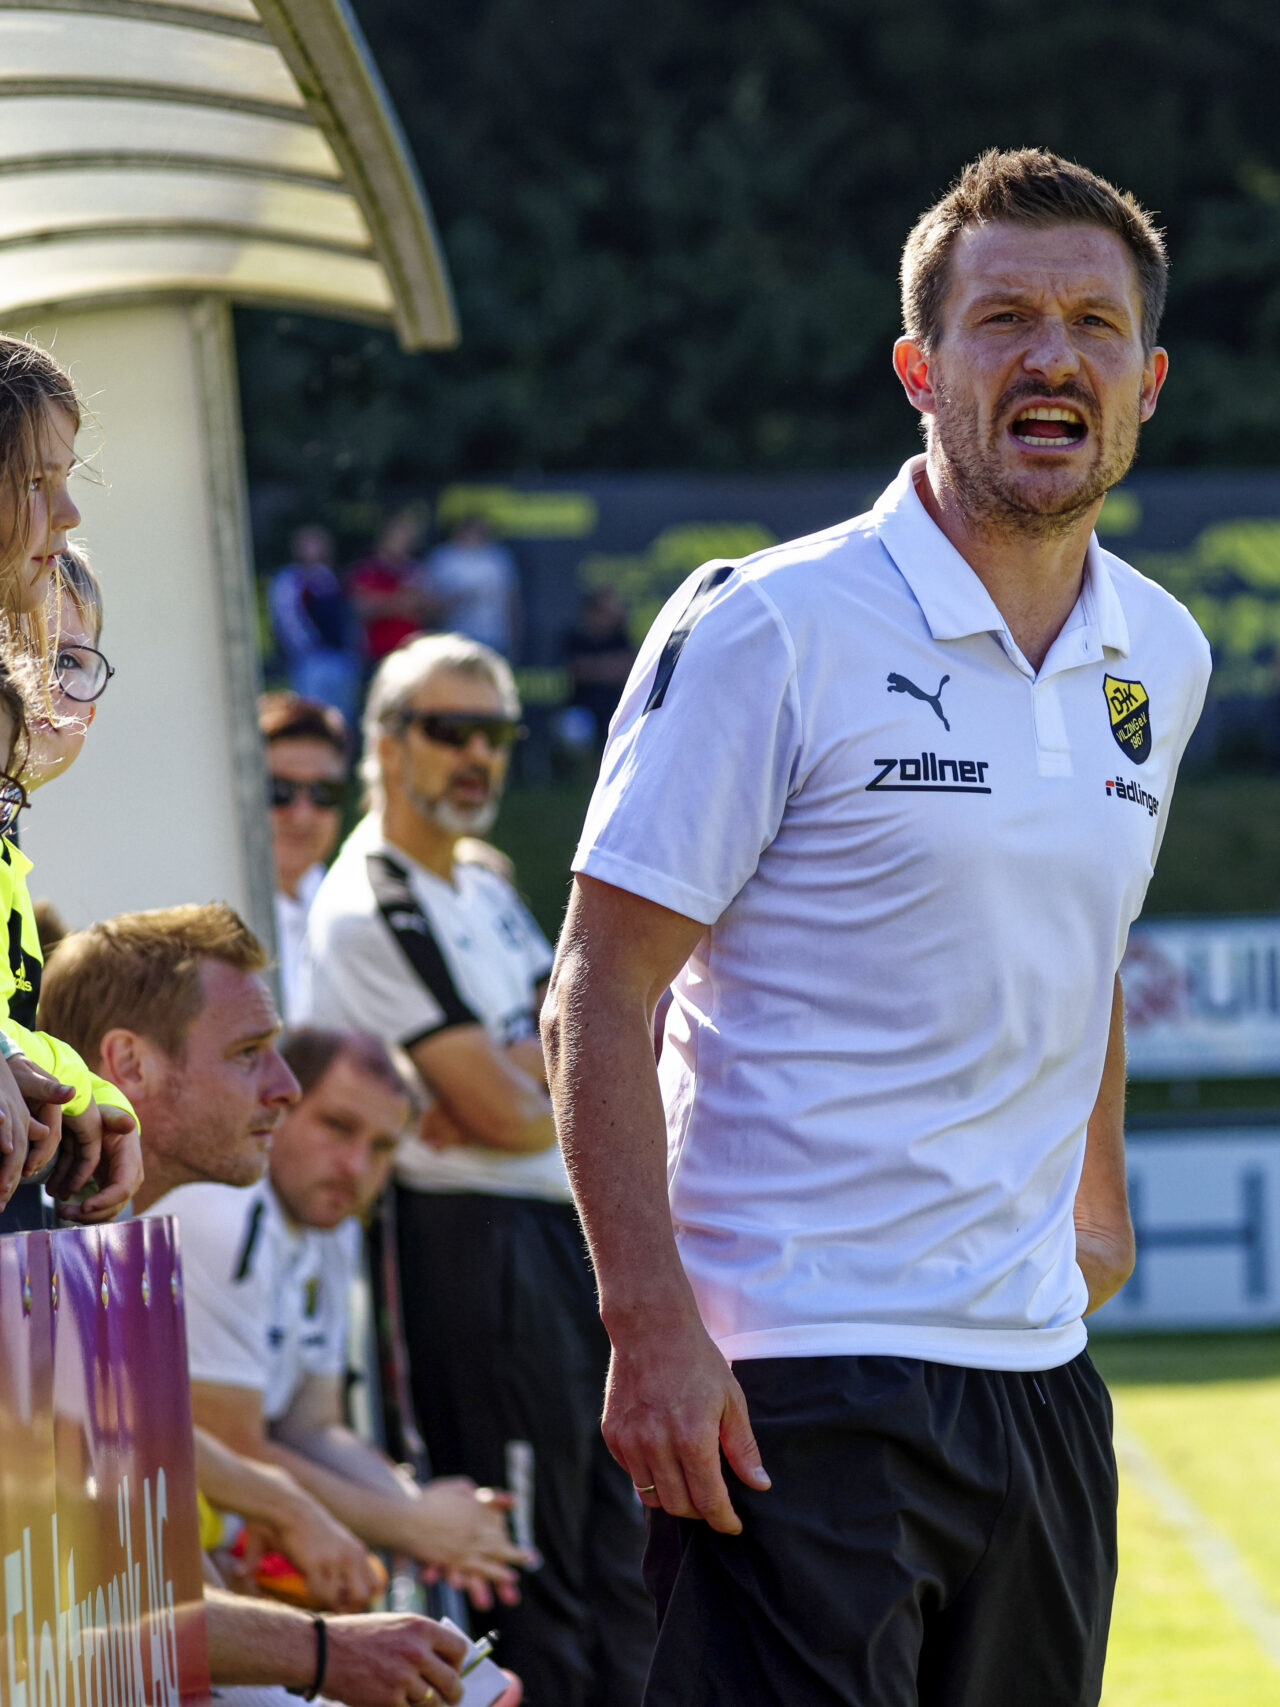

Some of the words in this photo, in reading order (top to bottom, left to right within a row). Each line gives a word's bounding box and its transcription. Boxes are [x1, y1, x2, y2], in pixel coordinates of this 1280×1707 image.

[1110, 683, 1139, 716] DJK
[1130, 730, 1143, 749] 1967
[865, 752, 992, 794] zollner
